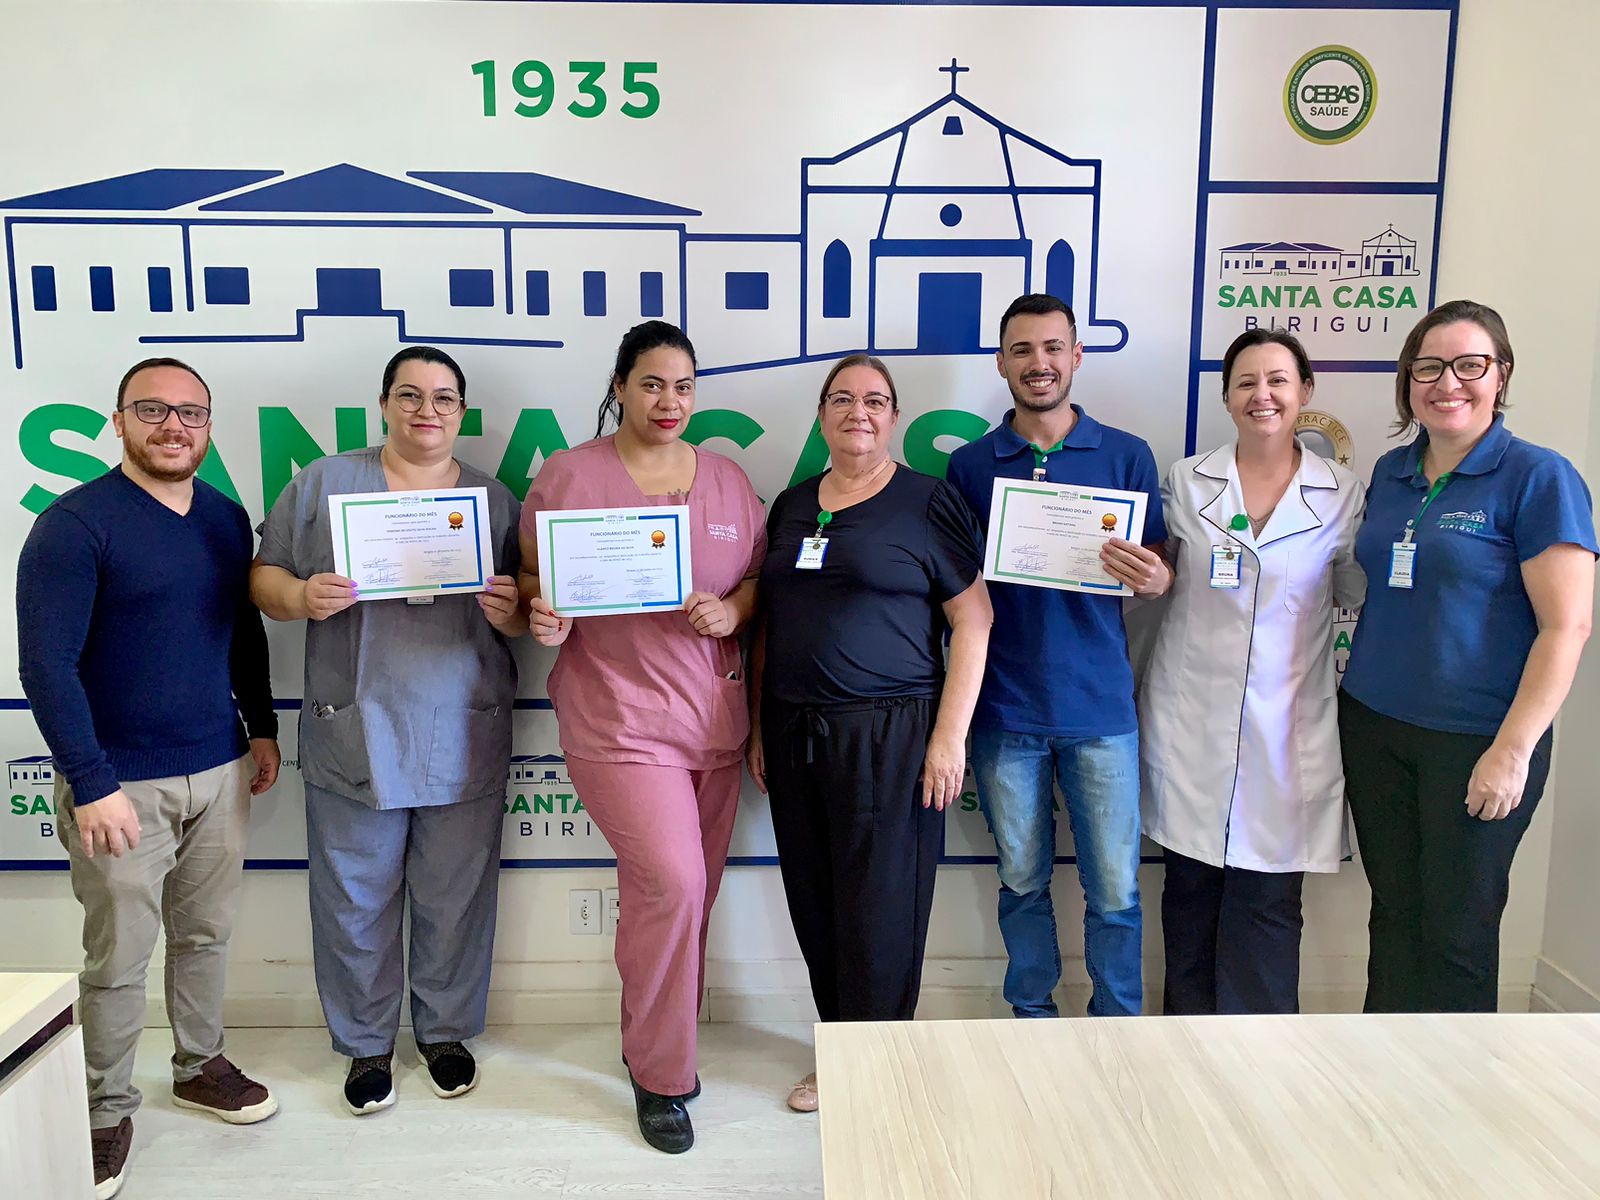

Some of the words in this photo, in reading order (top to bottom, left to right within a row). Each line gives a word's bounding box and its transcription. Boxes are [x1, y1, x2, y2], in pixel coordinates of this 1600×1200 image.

[471, 60, 662, 119] 1935
[1301, 85, 1360, 104] CEBAS
[1310, 104, 1349, 116] SAÚDE
[1217, 285, 1322, 308] SANTA
[1333, 286, 1418, 308] CASA
[1245, 316, 1388, 333] BIRIGUI
[1297, 415, 1347, 444] PRACTICE
[1041, 504, 1074, 513] FUNCIONÁRIO
[1440, 524, 1476, 534] BIRIGUI
[520, 822, 591, 836] BIRI
